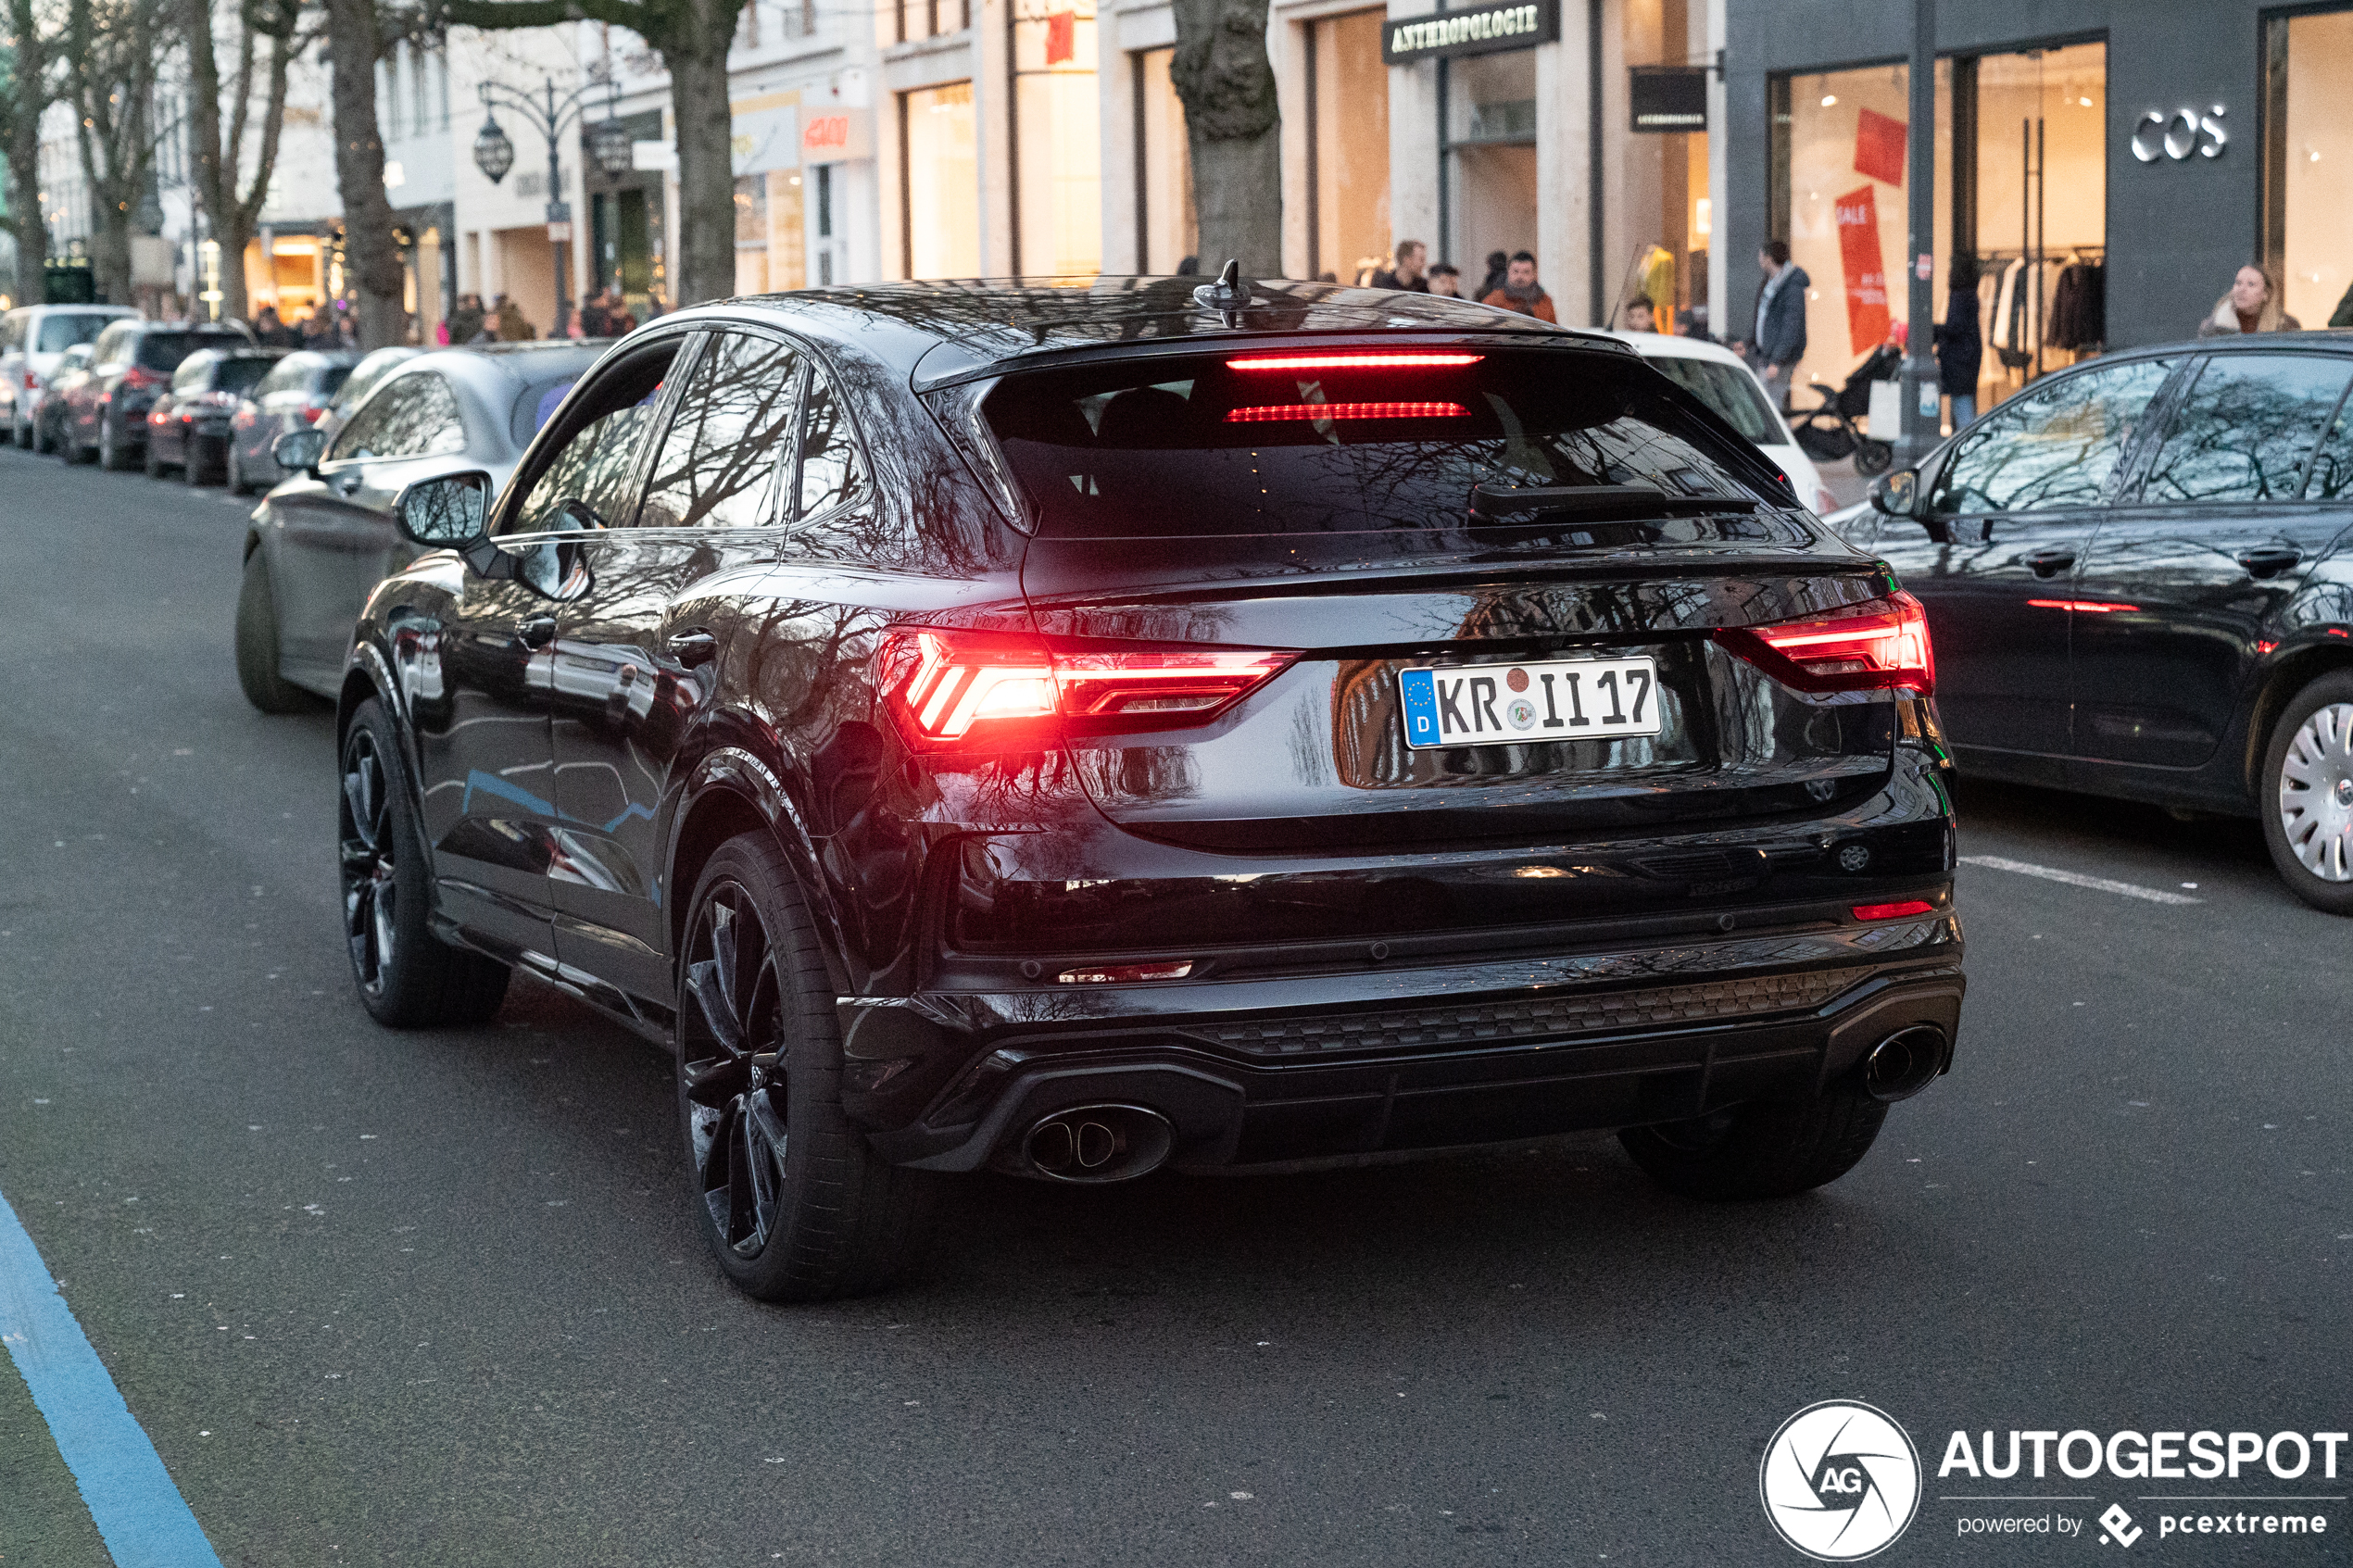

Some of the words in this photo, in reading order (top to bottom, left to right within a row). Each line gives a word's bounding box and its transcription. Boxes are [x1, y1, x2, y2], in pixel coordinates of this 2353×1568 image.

[1392, 5, 1538, 53] ANTHROPOLOGIE
[2132, 105, 2226, 162] COS
[1417, 716, 1429, 733] D
[1438, 676, 1503, 734] KR
[1541, 672, 1590, 727] II
[1597, 669, 1651, 725] 17
